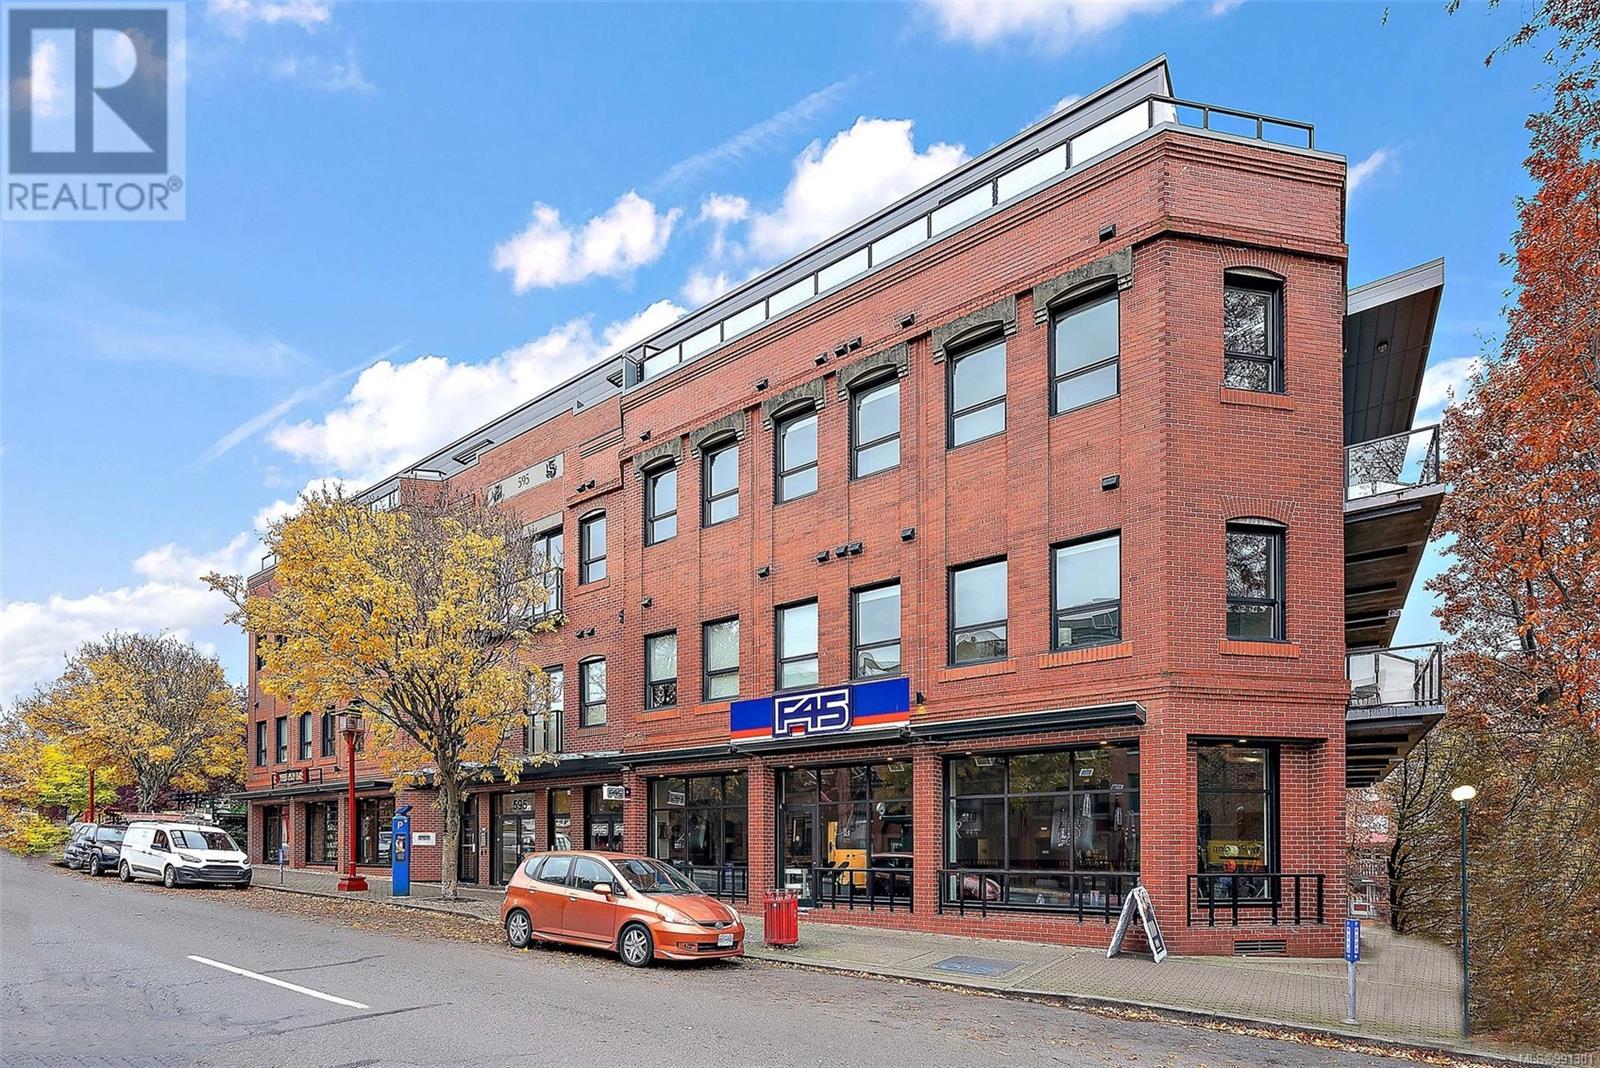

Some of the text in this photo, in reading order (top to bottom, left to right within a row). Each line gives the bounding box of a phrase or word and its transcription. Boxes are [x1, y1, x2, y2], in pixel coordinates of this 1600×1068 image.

[774, 688, 850, 735] F45
[513, 800, 528, 810] 595
[397, 821, 403, 829] P
[591, 823, 609, 836] F45
